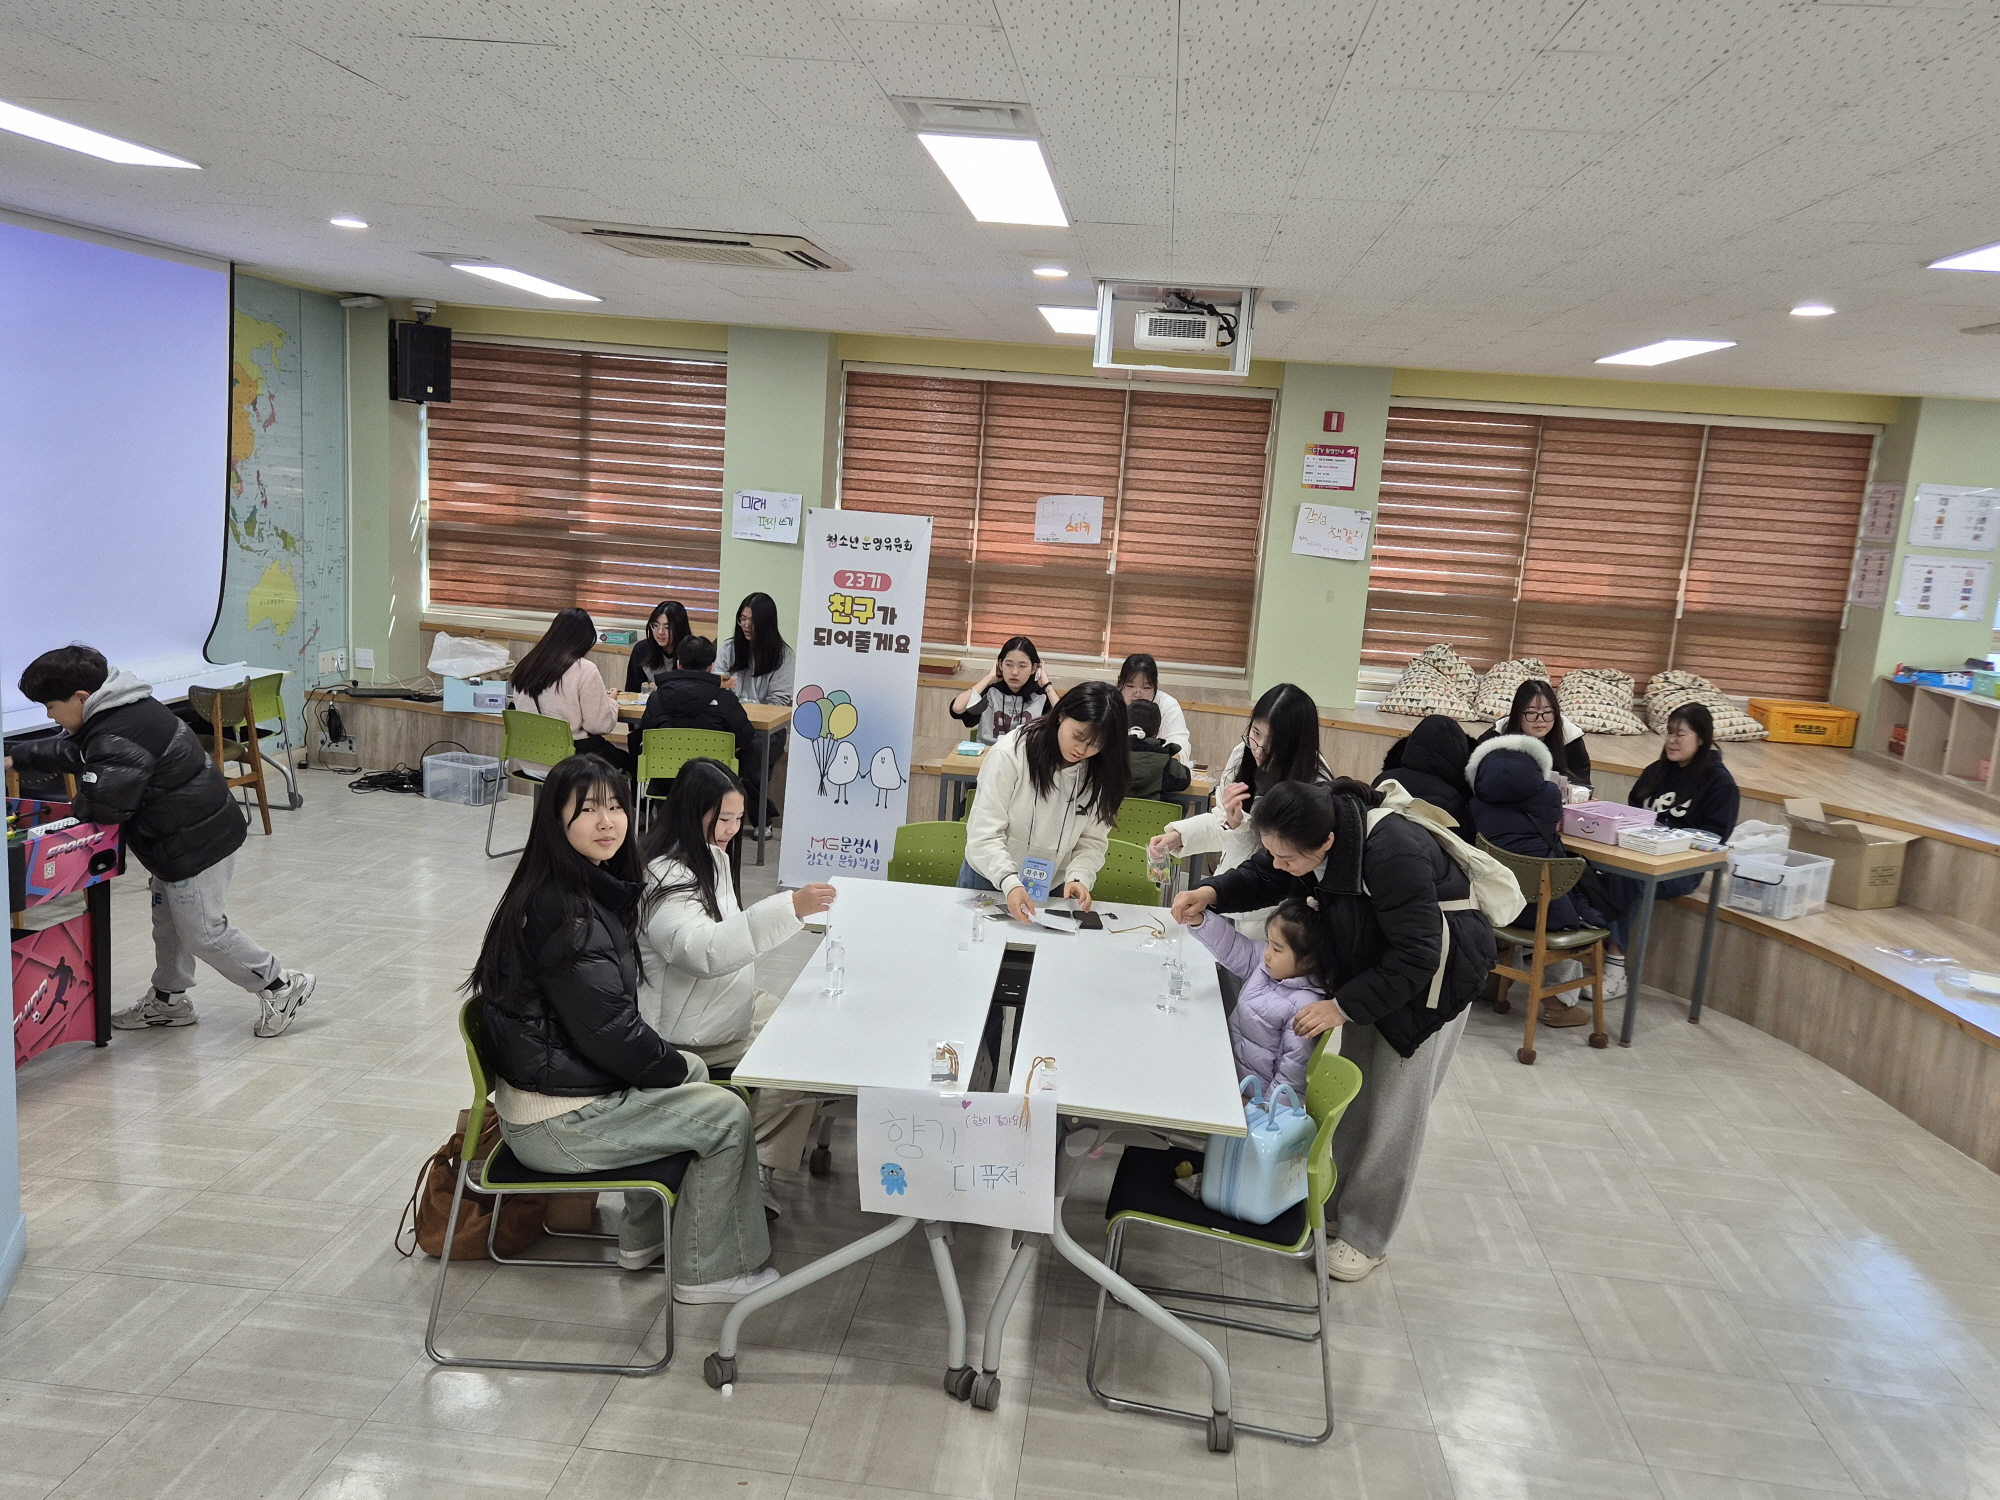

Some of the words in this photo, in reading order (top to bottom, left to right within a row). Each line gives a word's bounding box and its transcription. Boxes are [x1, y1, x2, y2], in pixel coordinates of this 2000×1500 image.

[741, 495, 767, 511] 미래
[757, 515, 777, 530] 편지
[779, 516, 794, 527] 쓰기
[845, 572, 882, 589] 23기
[828, 592, 898, 625] 친구가
[813, 627, 911, 654] 되어줄게요
[47, 831, 106, 856] SPORTS
[806, 850, 834, 866] 청소년
[838, 854, 880, 872] 문화의집
[879, 1108, 957, 1159] 향기
